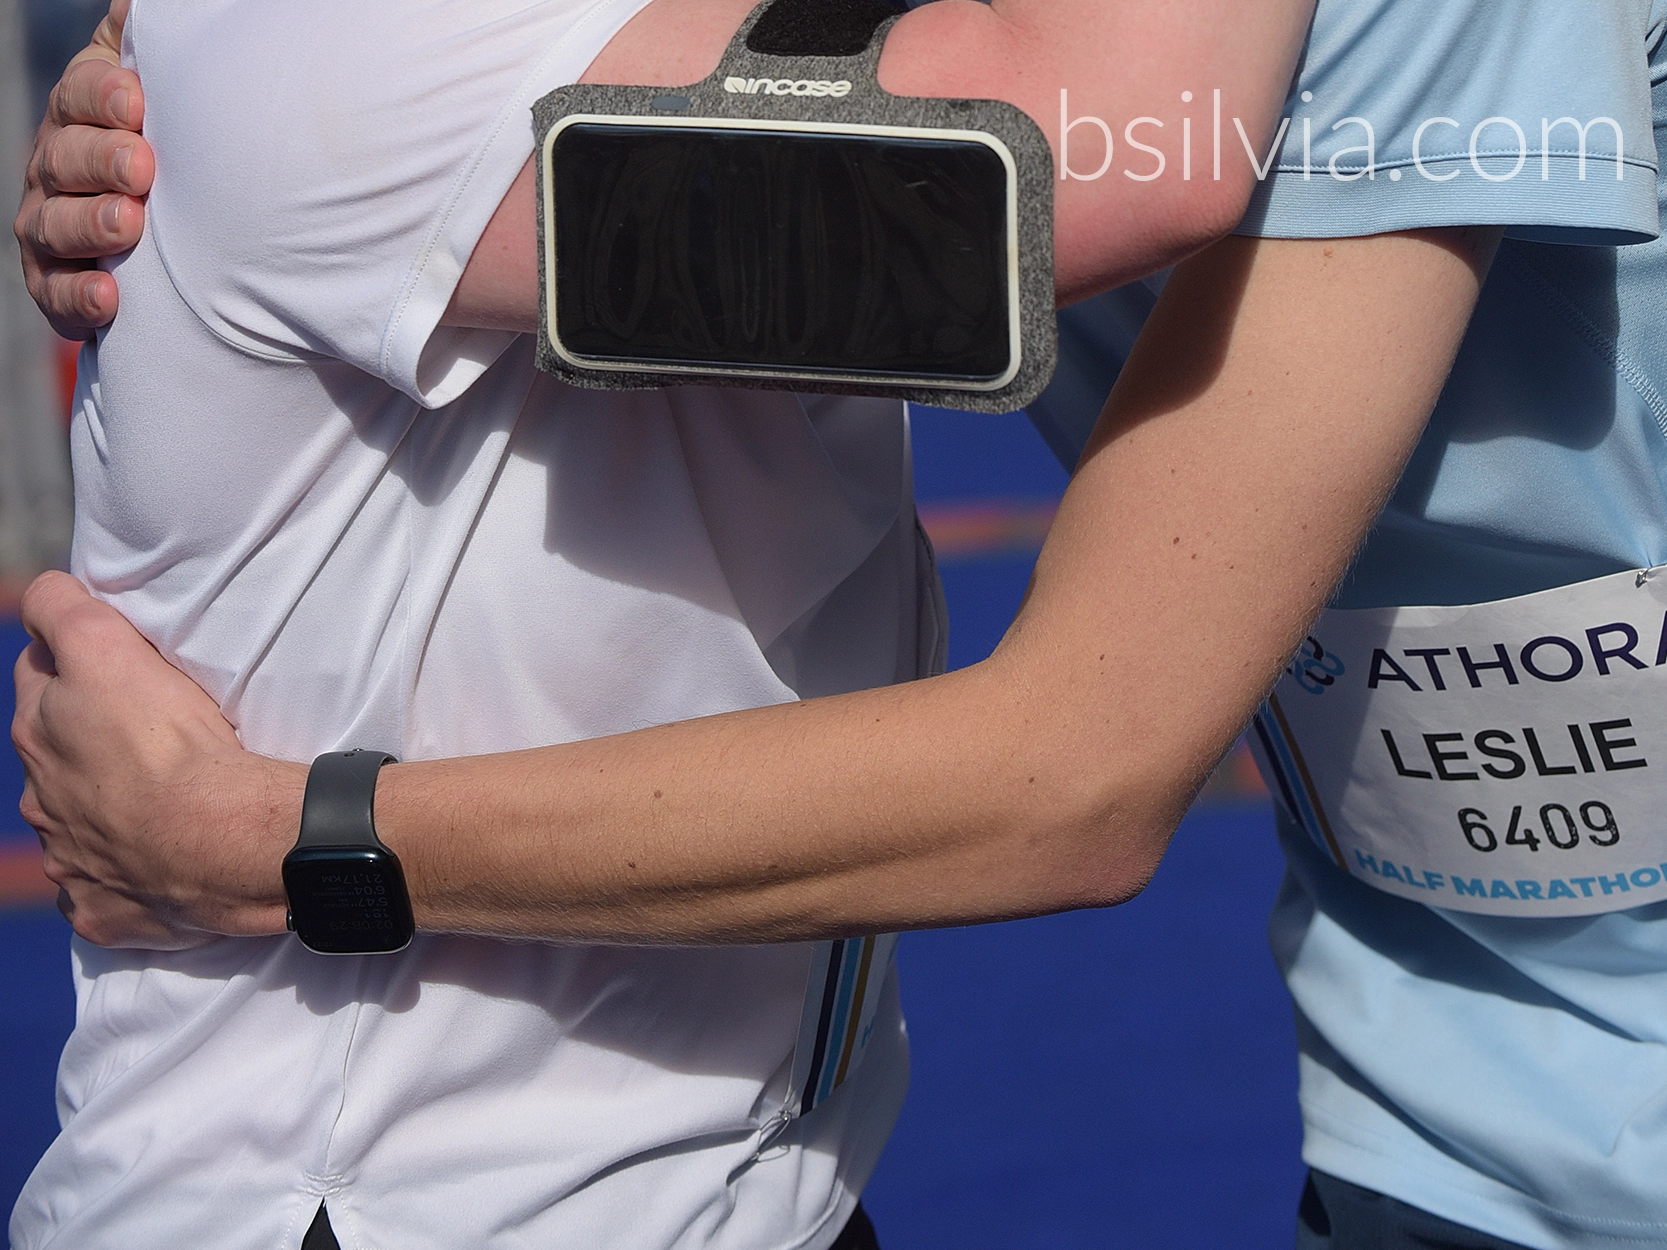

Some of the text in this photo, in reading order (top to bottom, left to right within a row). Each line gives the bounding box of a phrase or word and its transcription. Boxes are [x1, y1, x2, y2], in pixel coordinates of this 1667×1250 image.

[745, 78, 852, 97] incase
[1367, 610, 1667, 691] ATHOR
[1381, 718, 1648, 781] LESLIE
[1457, 800, 1620, 852] 6409
[1354, 849, 1667, 900] HALF MARATHO
[329, 919, 393, 931] 02:08:29
